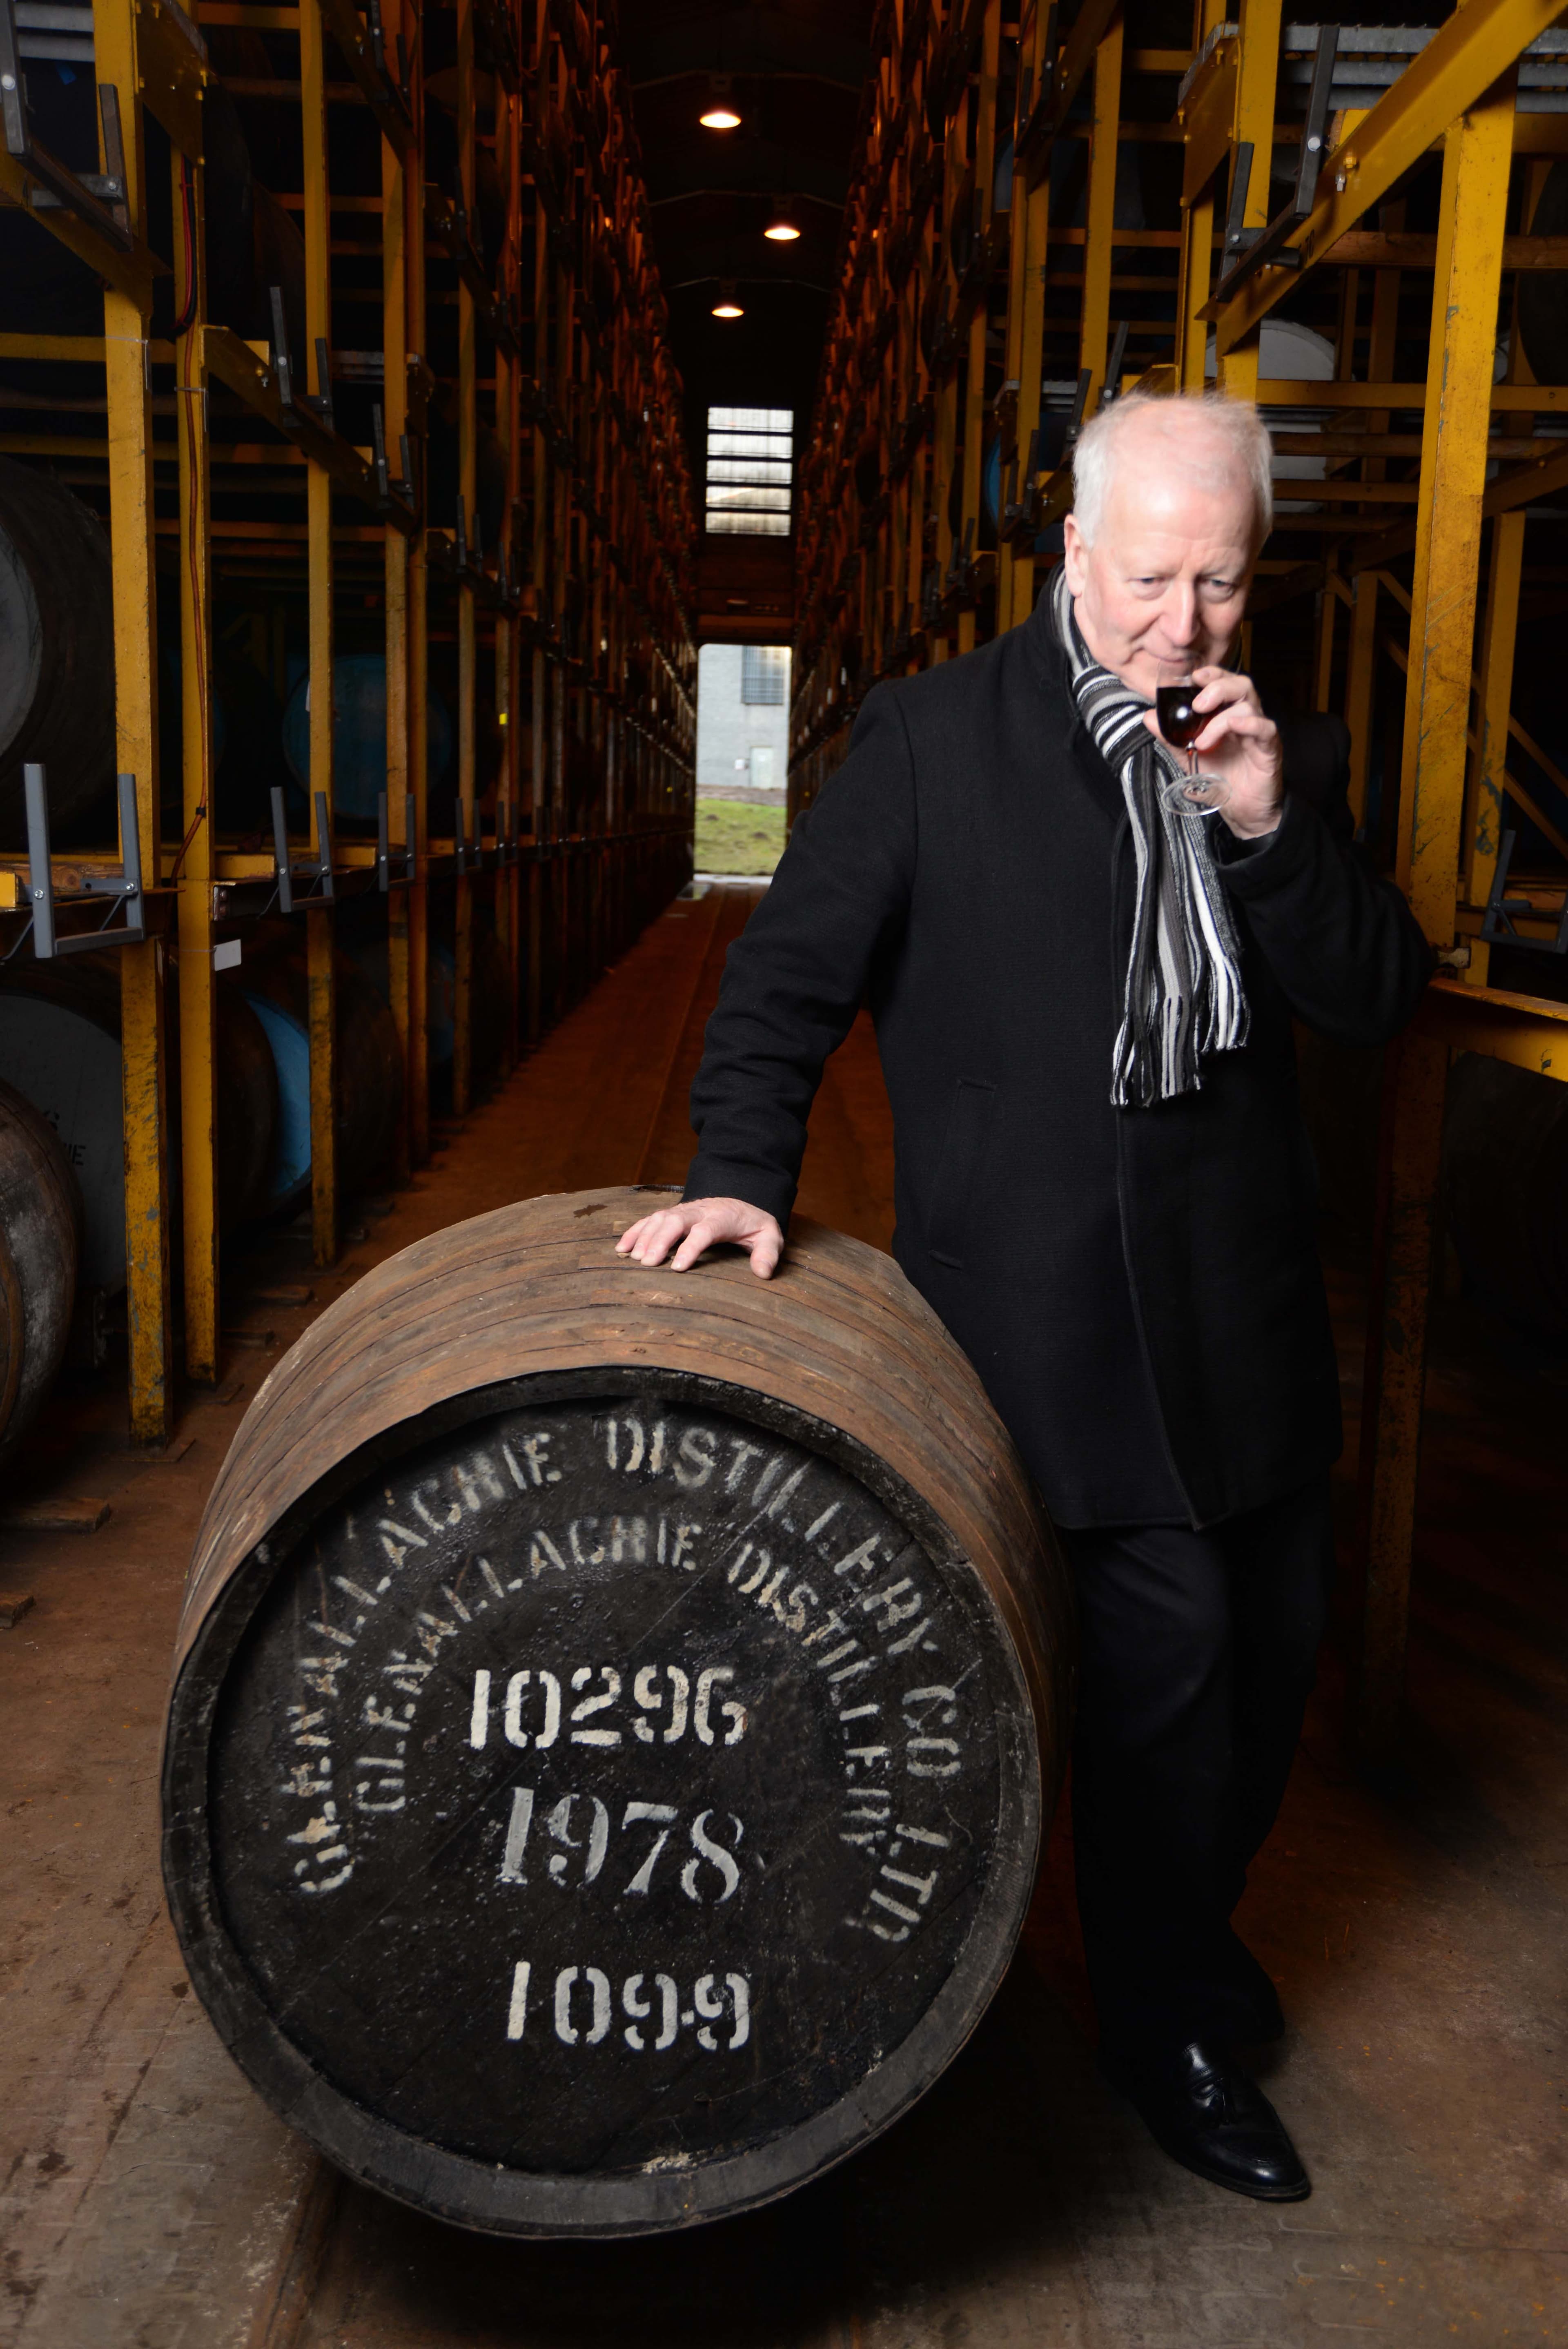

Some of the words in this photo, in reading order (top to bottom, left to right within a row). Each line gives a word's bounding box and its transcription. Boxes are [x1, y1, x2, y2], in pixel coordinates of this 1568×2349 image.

[607, 1418, 938, 1655] DISTILLERY
[283, 1433, 563, 1892] GLENALLACHIE
[356, 1514, 702, 1812] GLENALLACHIE
[728, 1543, 891, 1855] DISTILLERY
[470, 1665, 748, 1750] 10296
[902, 1685, 961, 1776] CO
[495, 1787, 744, 1904] 1978
[870, 1824, 949, 1942] LTD
